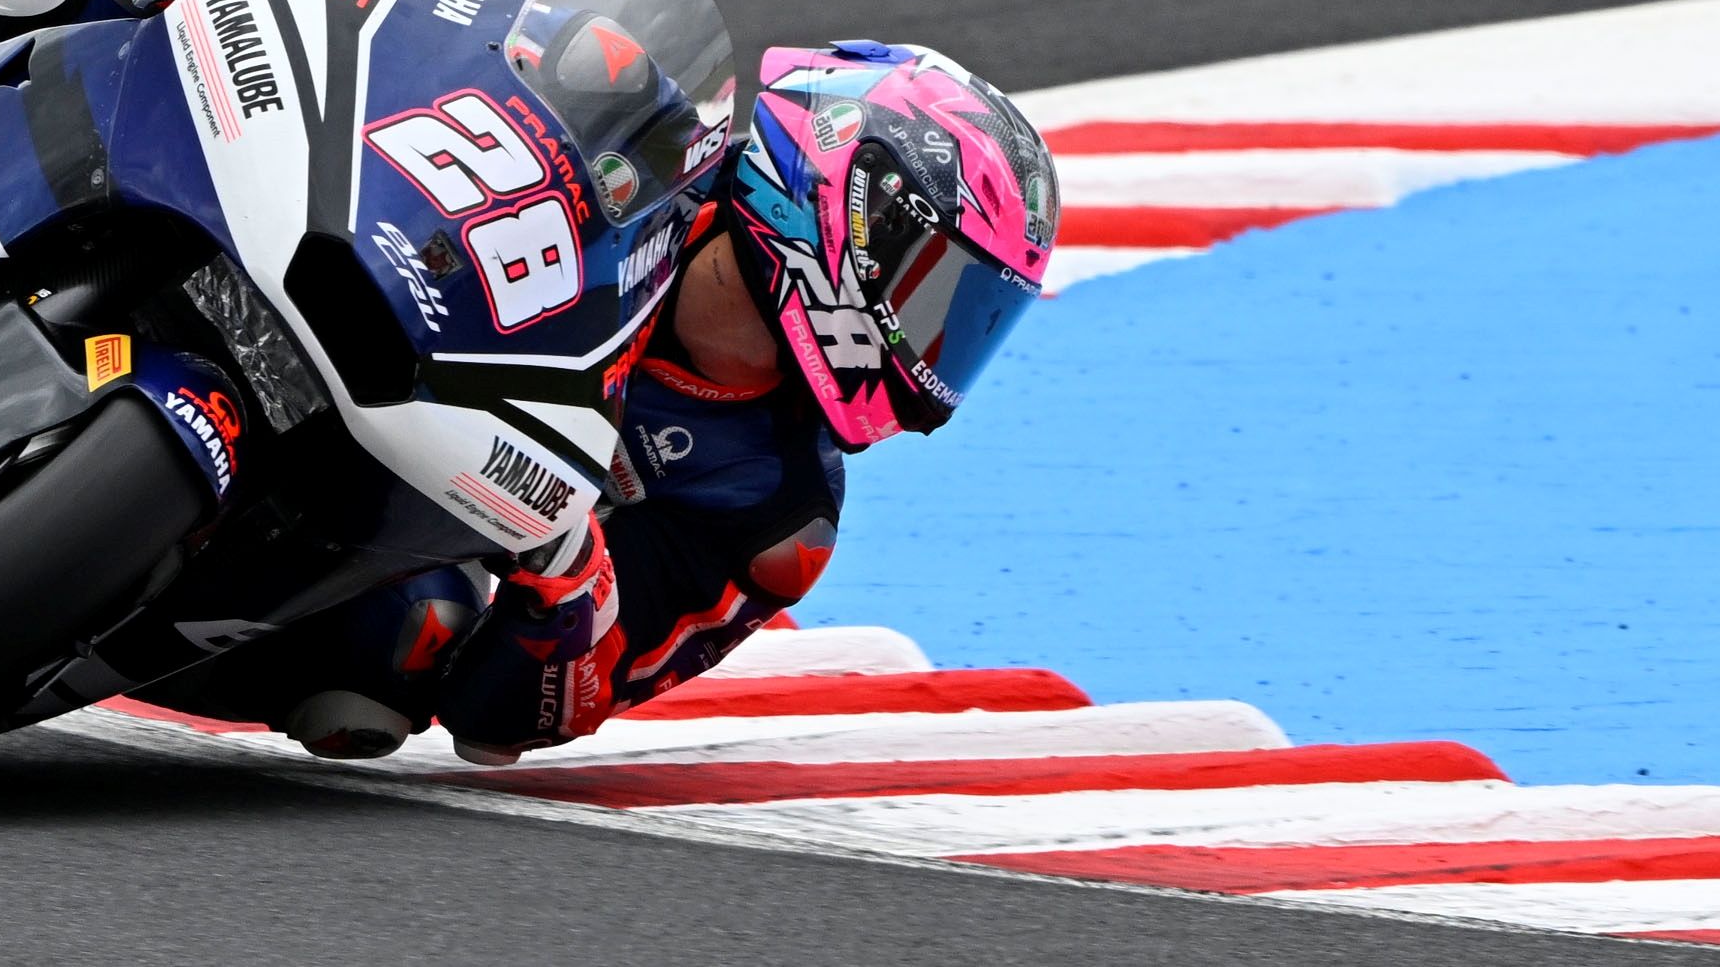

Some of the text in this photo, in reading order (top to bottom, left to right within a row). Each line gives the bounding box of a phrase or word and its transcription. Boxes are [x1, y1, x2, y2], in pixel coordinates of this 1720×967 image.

[176, 20, 221, 138] Liquid Engine Component
[506, 95, 592, 225] PRAMAC
[682, 117, 729, 175] WRS
[900, 140, 945, 200] Financial
[362, 87, 584, 335] 28
[895, 195, 938, 235] OAKLEY
[618, 221, 674, 297] YAMAHA
[94, 336, 122, 382] PIRELLI
[785, 308, 837, 399] PRAMAC
[164, 391, 231, 495] YAMAHA
[480, 434, 577, 522] YAMALUBE
[635, 424, 667, 479] PRAMAC
[444, 489, 528, 541] Liquid Engine Component
